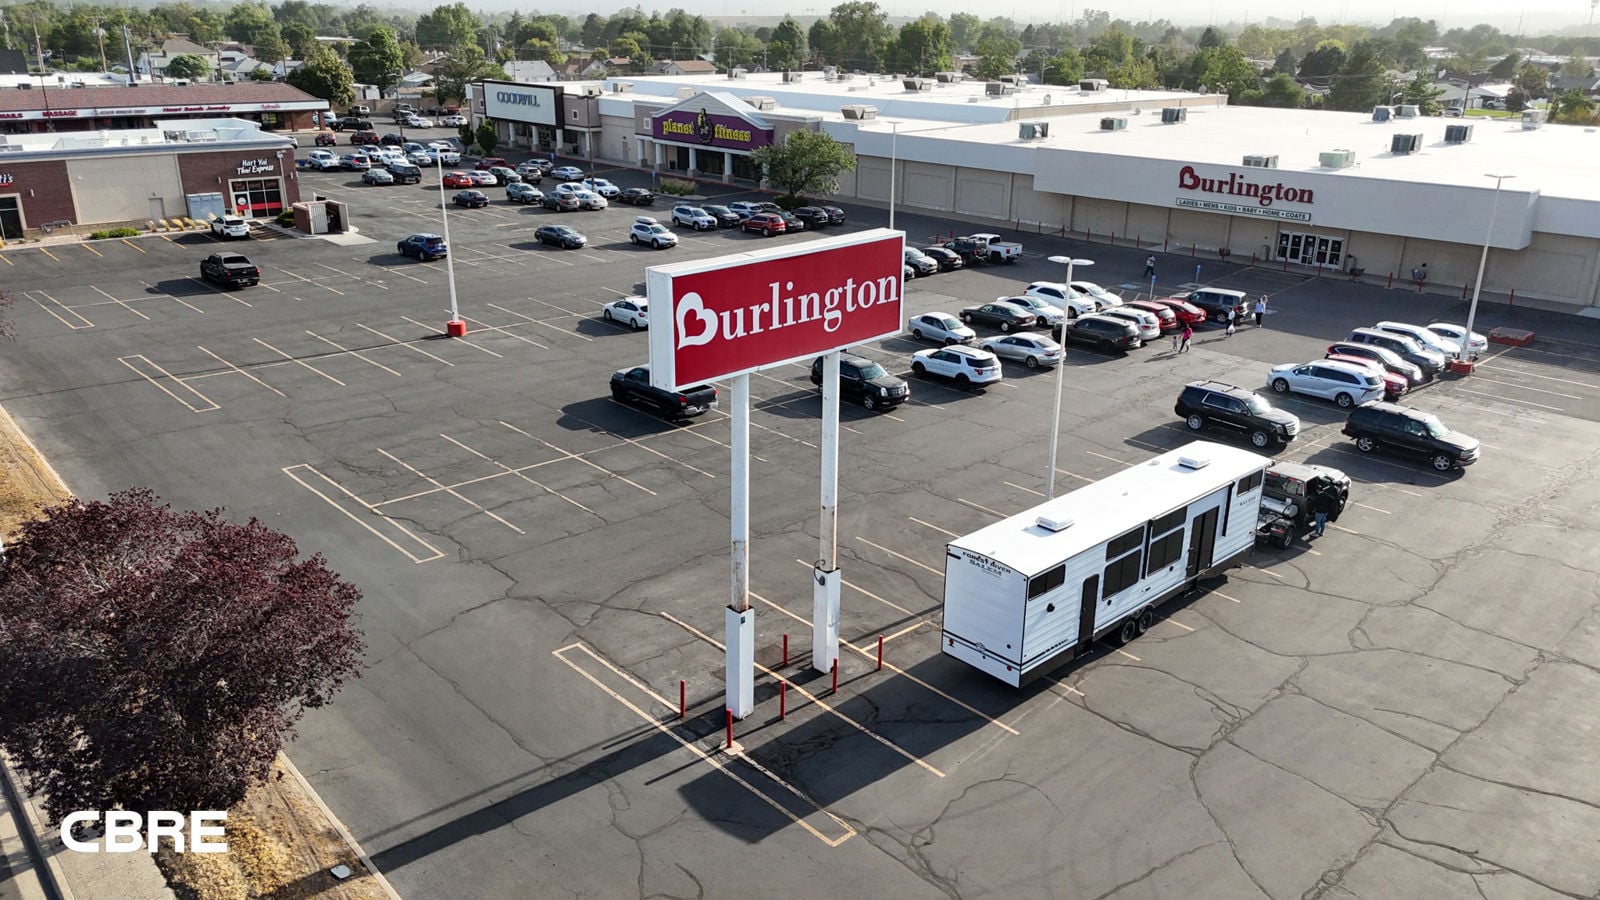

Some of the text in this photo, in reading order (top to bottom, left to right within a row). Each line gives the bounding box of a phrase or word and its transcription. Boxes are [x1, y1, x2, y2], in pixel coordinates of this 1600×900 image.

[496, 91, 538, 106] GOODWILL
[662, 119, 751, 142] planet fitness
[1178, 166, 1314, 207] Burlington
[1179, 199, 1199, 207] LADIES
[1242, 206, 1258, 214] BABY
[1262, 209, 1281, 217] HOME
[1285, 212, 1306, 220] COATS
[676, 275, 899, 350] Burlington
[962, 551, 989, 565] FOREST
[990, 560, 1011, 574] RIVER
[969, 559, 1003, 577] SALEM
